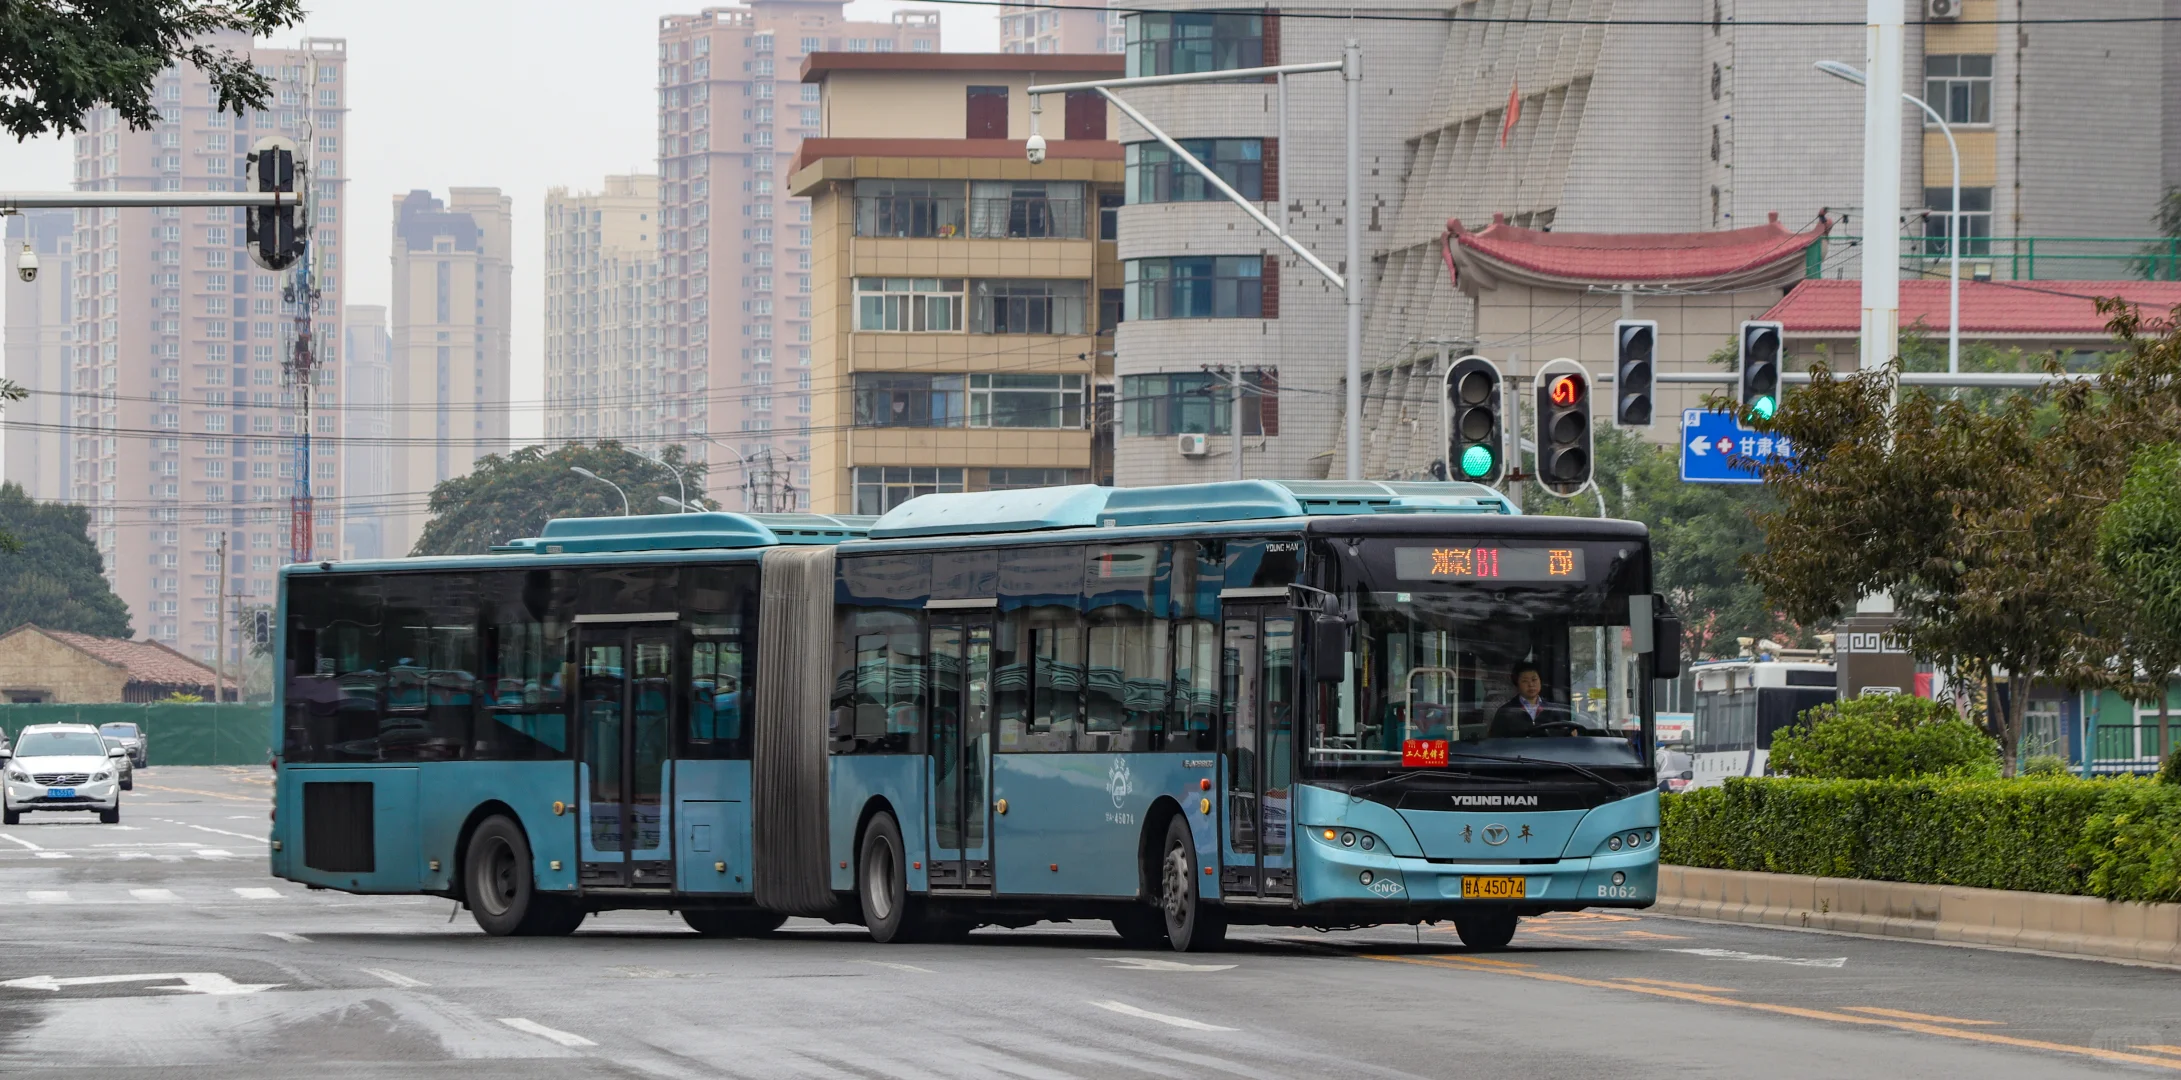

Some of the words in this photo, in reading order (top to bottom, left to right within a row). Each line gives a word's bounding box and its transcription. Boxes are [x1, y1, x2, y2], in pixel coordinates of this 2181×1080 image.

[1739, 436, 1791, 457] 甘肃省
[1265, 543, 1284, 552] YOUNG
[1285, 542, 1299, 551] MAN
[1476, 548, 1498, 577] B1
[1451, 795, 1502, 806] YOUNG
[1503, 795, 1538, 806] MAN
[1517, 824, 1534, 844] 年
[1374, 883, 1397, 893] CNG
[1597, 884, 1637, 898] B062
